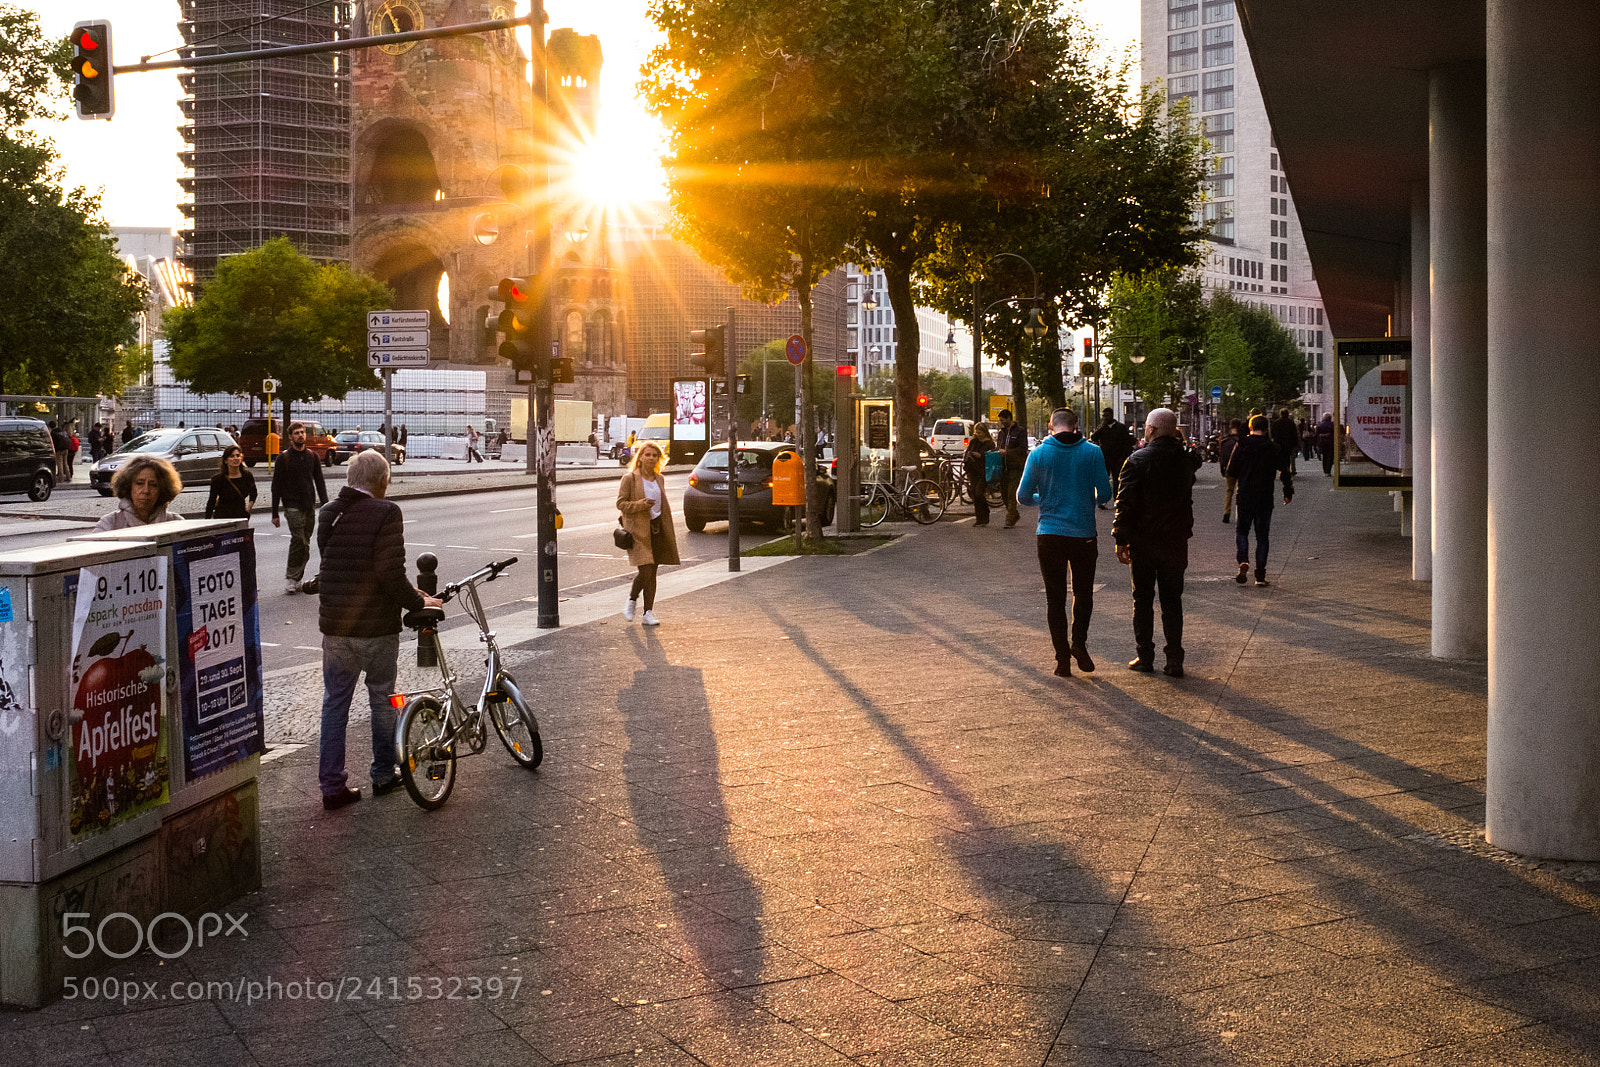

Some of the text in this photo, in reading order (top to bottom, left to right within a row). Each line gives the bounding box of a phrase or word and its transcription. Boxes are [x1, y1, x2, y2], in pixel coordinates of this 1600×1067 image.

[1368, 396, 1401, 405] DETAILS
[1382, 406, 1401, 415] ZUM
[1357, 416, 1401, 424] VERLIEBEN
[198, 570, 234, 595] FOTO
[122, 597, 163, 620] potsdam
[200, 597, 236, 623] TAGE
[204, 624, 236, 651] 2017
[86, 680, 148, 708] Historisches
[77, 702, 158, 768] Apfelfest
